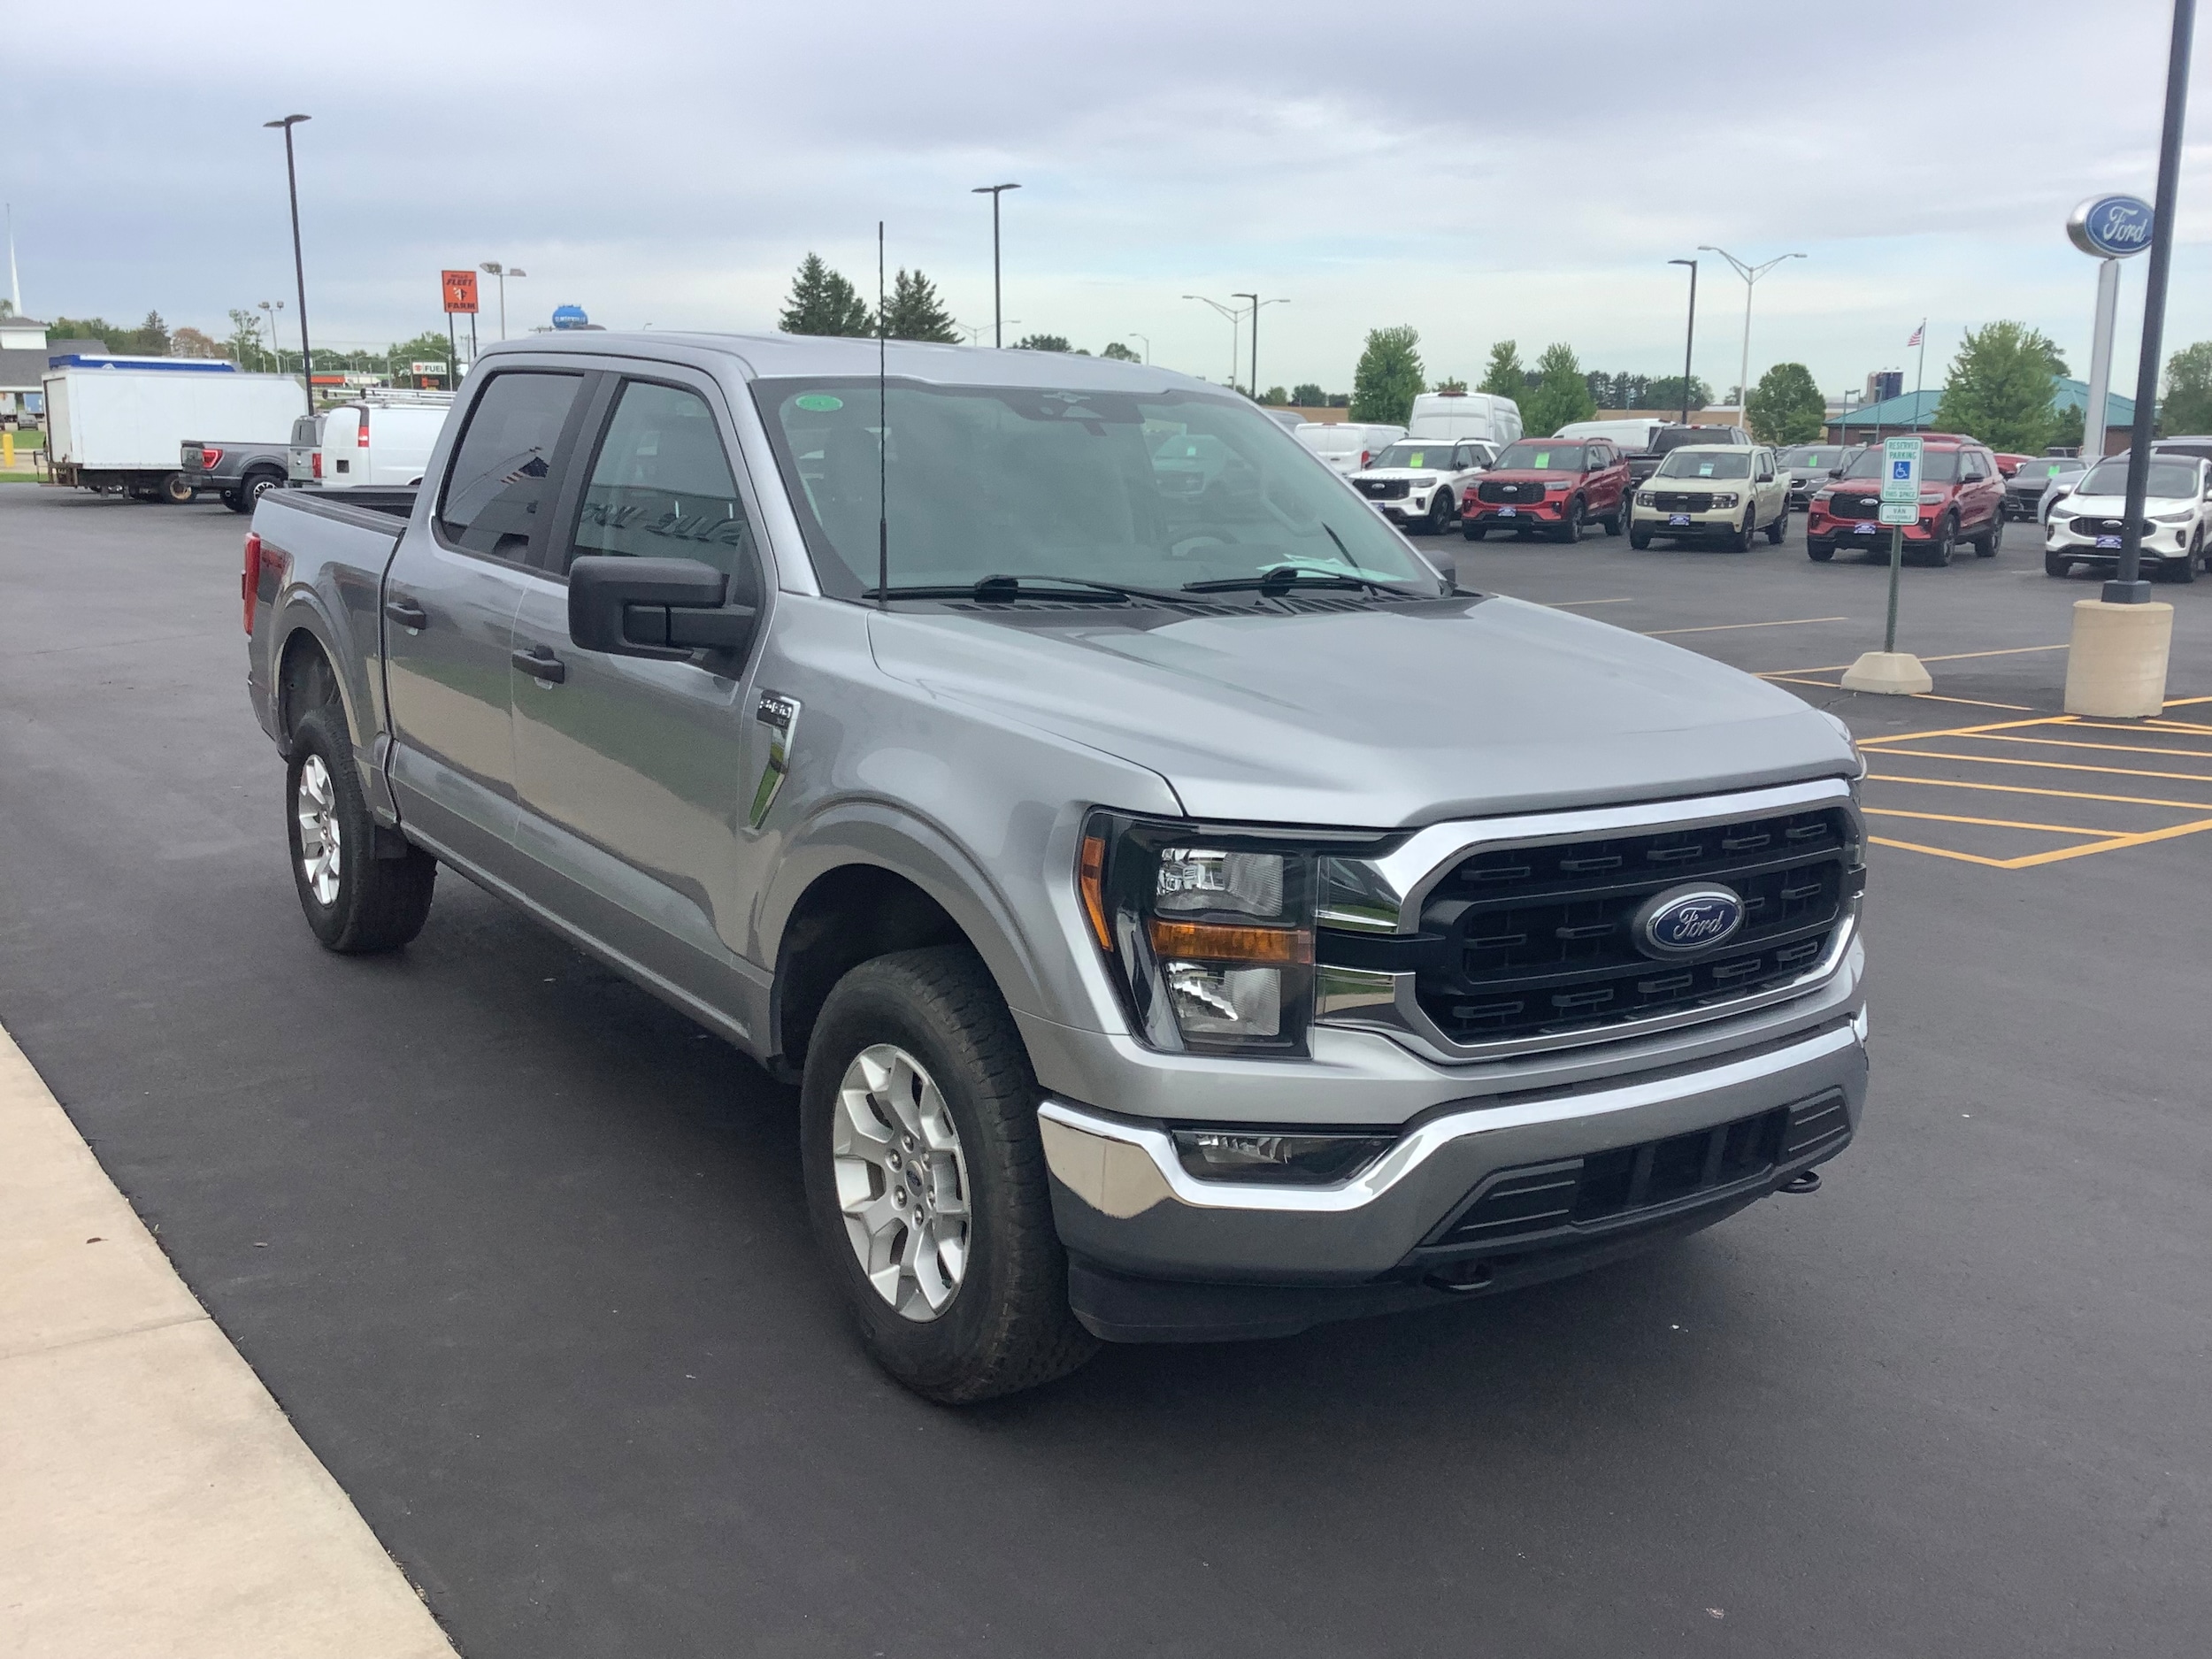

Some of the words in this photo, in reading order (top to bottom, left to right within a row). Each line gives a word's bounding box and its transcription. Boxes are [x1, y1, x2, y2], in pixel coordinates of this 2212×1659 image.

[2103, 205, 2147, 242] Ford
[1888, 442, 1918, 450] RESERVED
[1889, 451, 1916, 460] PARKING
[1673, 905, 1724, 940] Ford
